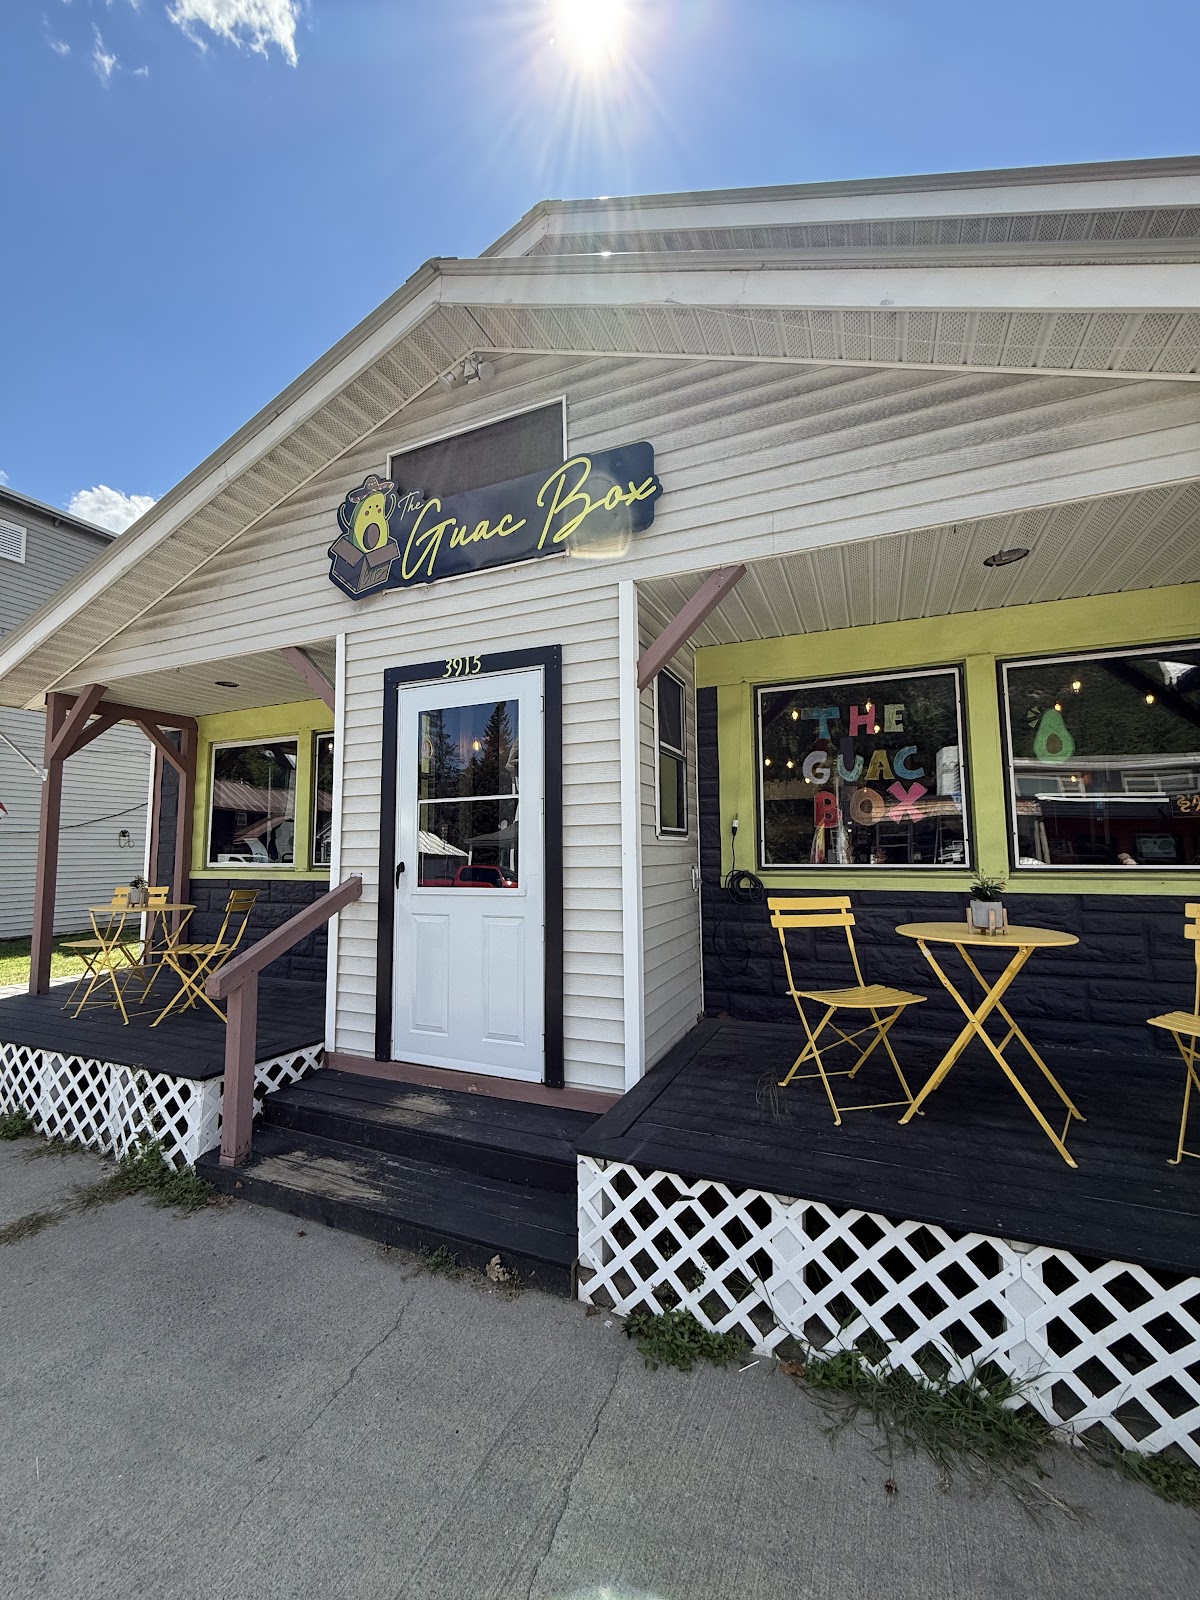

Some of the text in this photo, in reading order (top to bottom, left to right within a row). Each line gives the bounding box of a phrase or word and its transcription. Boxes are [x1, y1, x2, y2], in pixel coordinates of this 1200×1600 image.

[398, 457, 657, 579] The Guac Box
[442, 655, 481, 678] 3915
[801, 703, 905, 739] THE
[802, 745, 925, 785] GUAC
[814, 781, 928, 828] BOX
